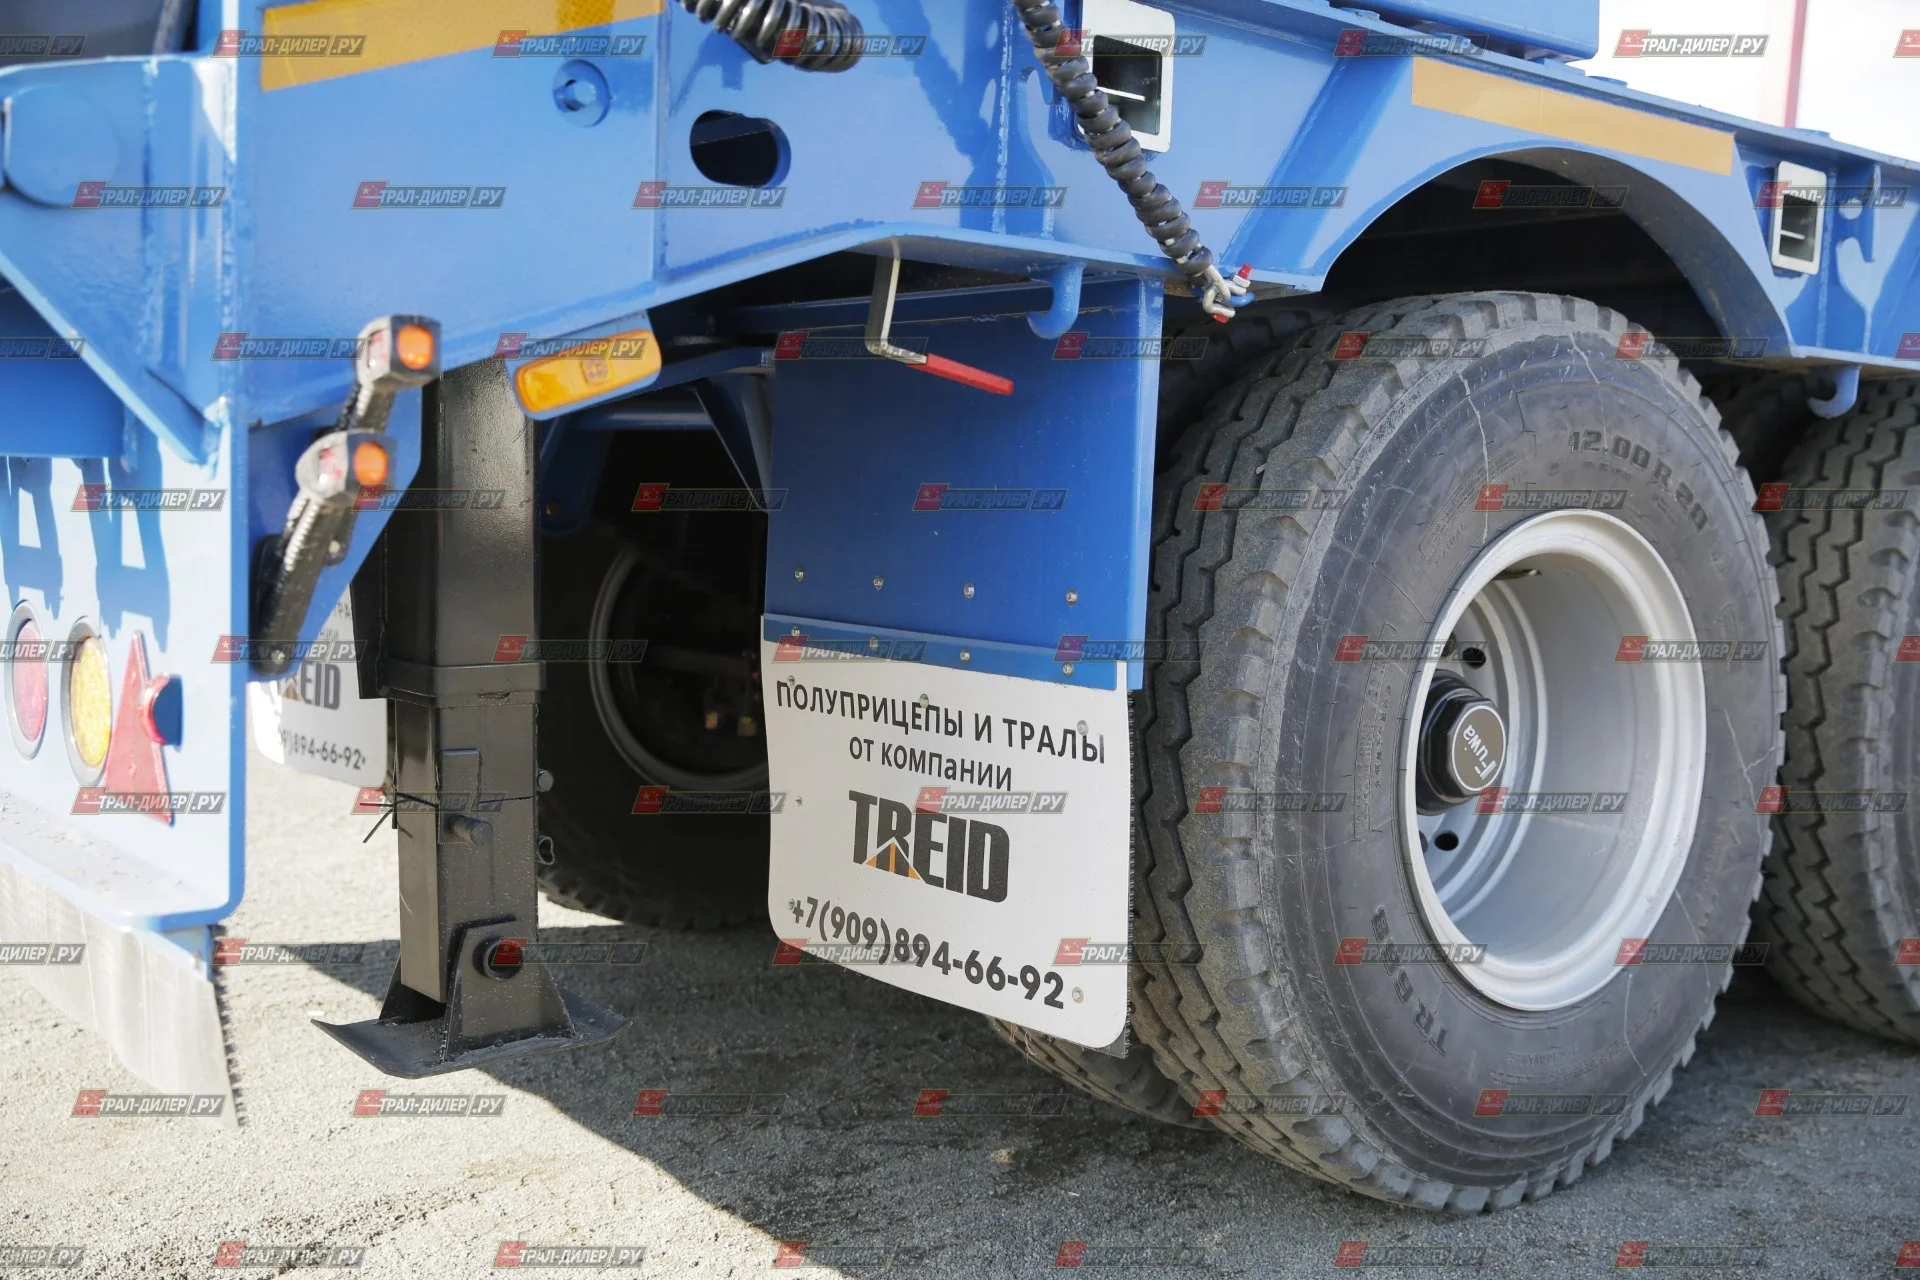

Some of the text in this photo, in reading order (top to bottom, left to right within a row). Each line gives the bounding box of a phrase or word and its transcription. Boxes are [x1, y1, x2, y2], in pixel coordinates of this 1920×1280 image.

[776, 681, 1105, 764] ПОЛУПРИЦЕПЫ И ТРАЛЫ
[848, 789, 1010, 903] TREID
[792, 896, 1064, 1009] +7(909)894-66-92
